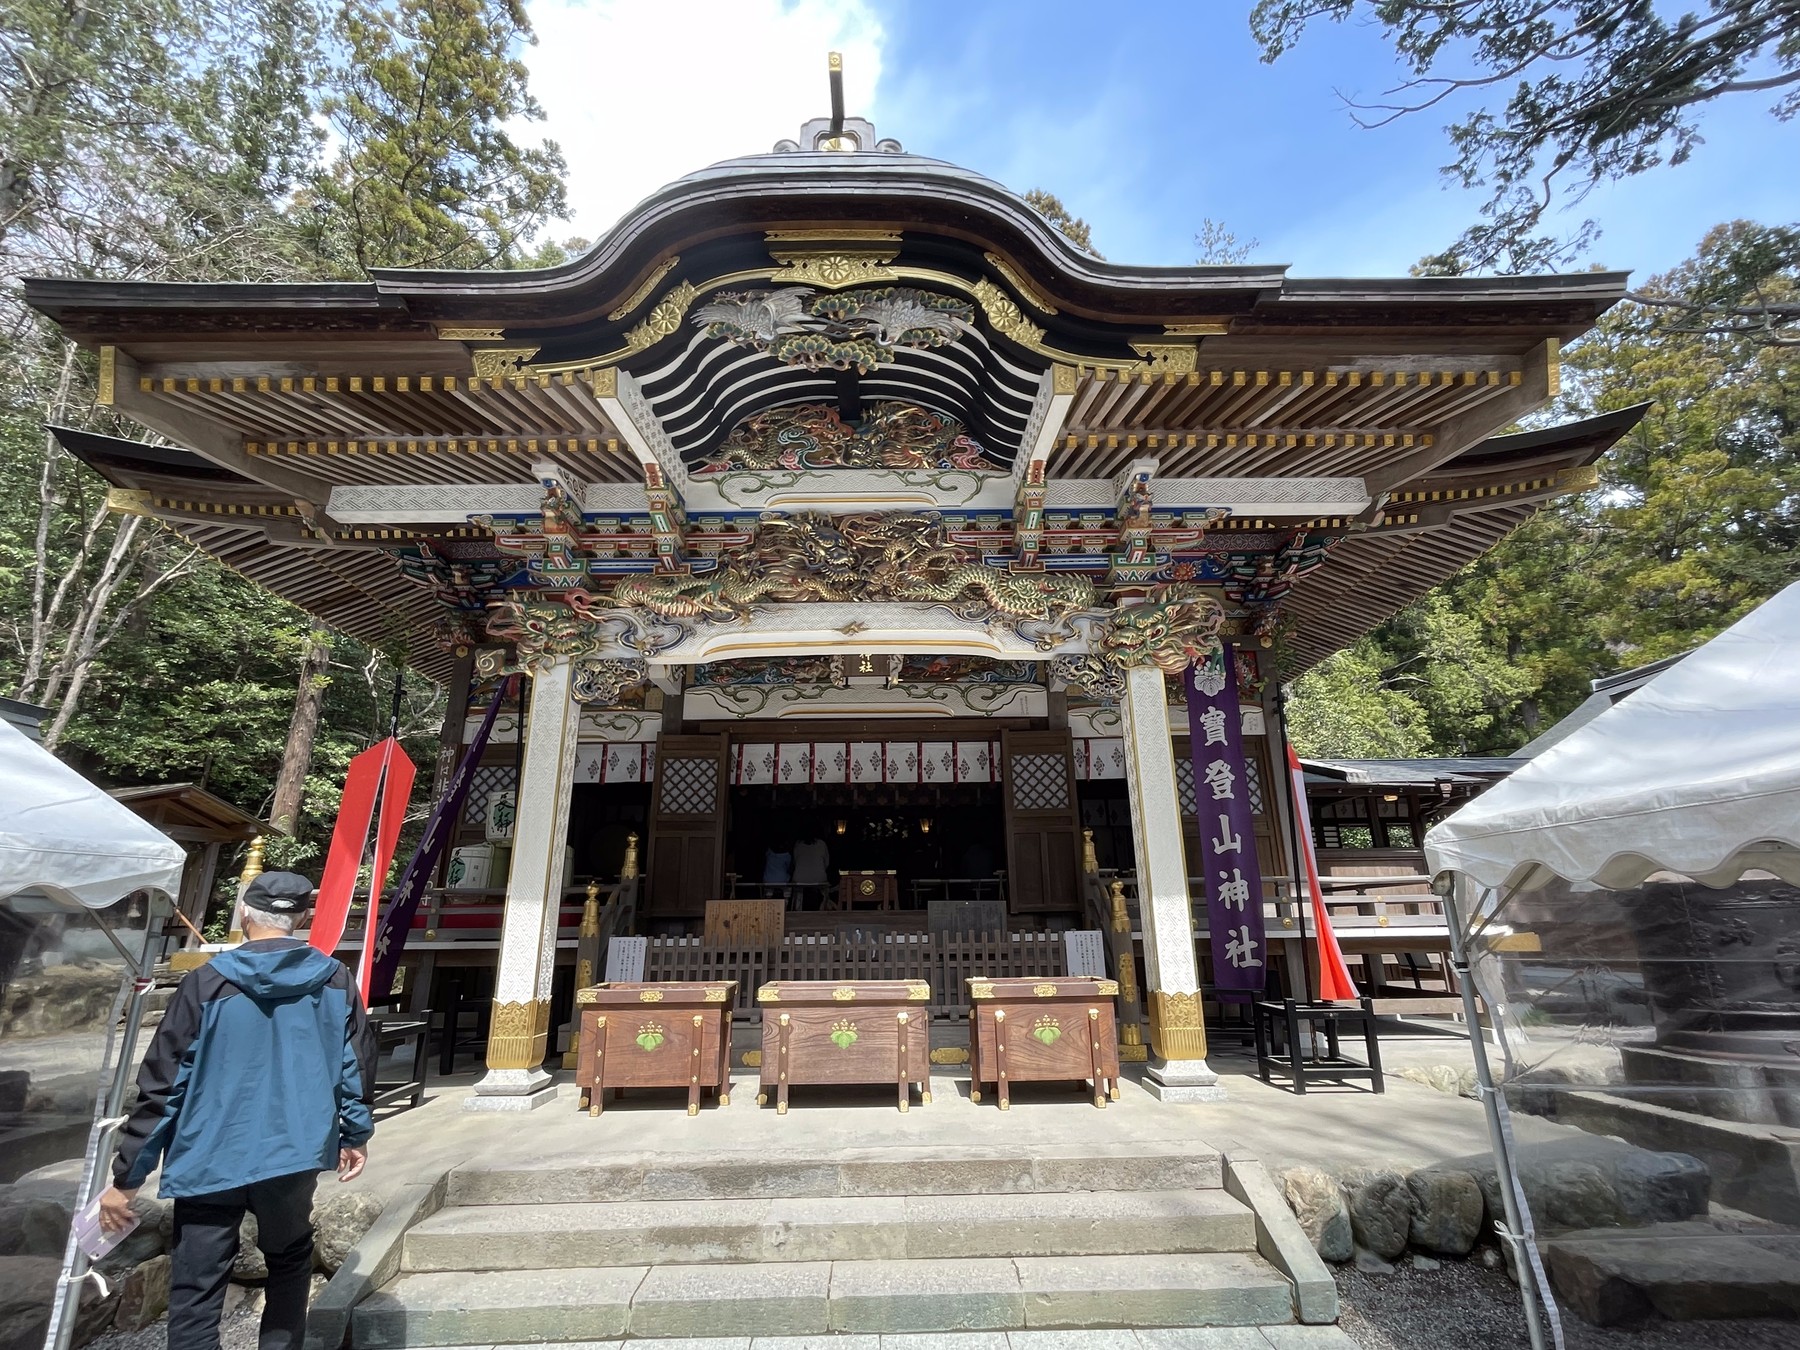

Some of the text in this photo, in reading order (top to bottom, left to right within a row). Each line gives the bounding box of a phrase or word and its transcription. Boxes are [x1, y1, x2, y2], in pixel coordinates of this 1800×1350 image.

[1200, 706, 1262, 968] 寶登山神社
